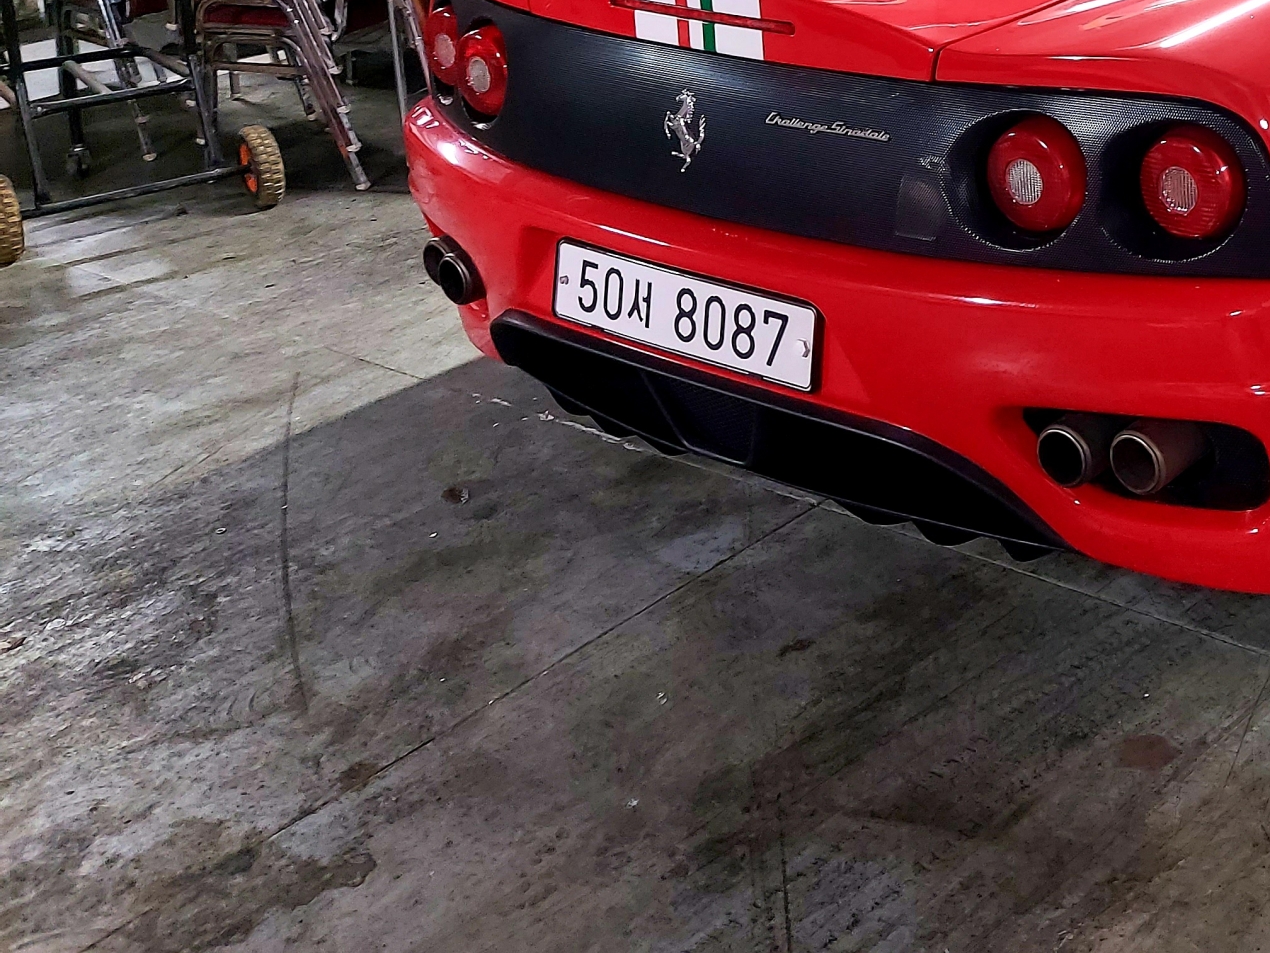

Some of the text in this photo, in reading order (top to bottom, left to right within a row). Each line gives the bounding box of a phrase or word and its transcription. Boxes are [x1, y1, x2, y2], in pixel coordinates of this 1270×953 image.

[765, 111, 828, 134] Challenge
[577, 259, 789, 367] 50서 8087
